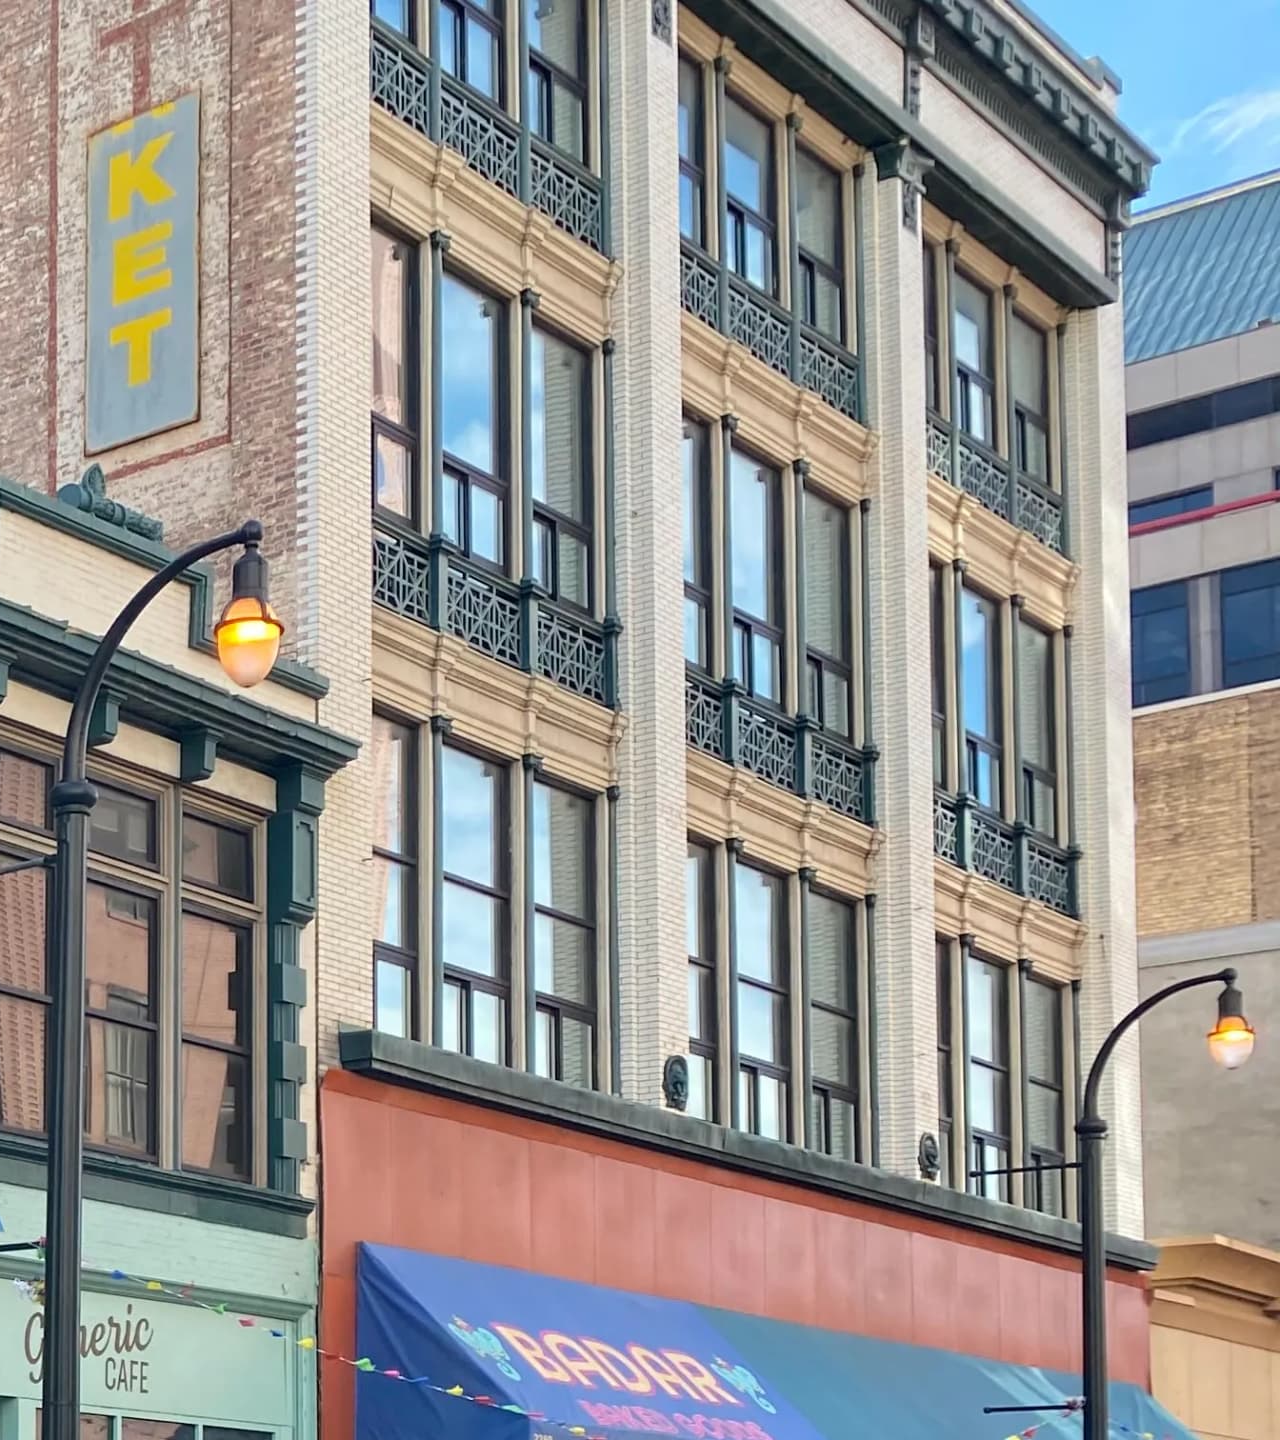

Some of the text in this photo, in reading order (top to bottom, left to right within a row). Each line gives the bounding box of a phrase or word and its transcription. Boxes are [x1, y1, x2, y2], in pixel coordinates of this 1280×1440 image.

[108, 101, 176, 388] KET
[24, 1303, 155, 1385] Gneric
[104, 1356, 150, 1394] CAFE
[489, 1320, 744, 1407] BADAR
[577, 1399, 679, 1434] BAKED
